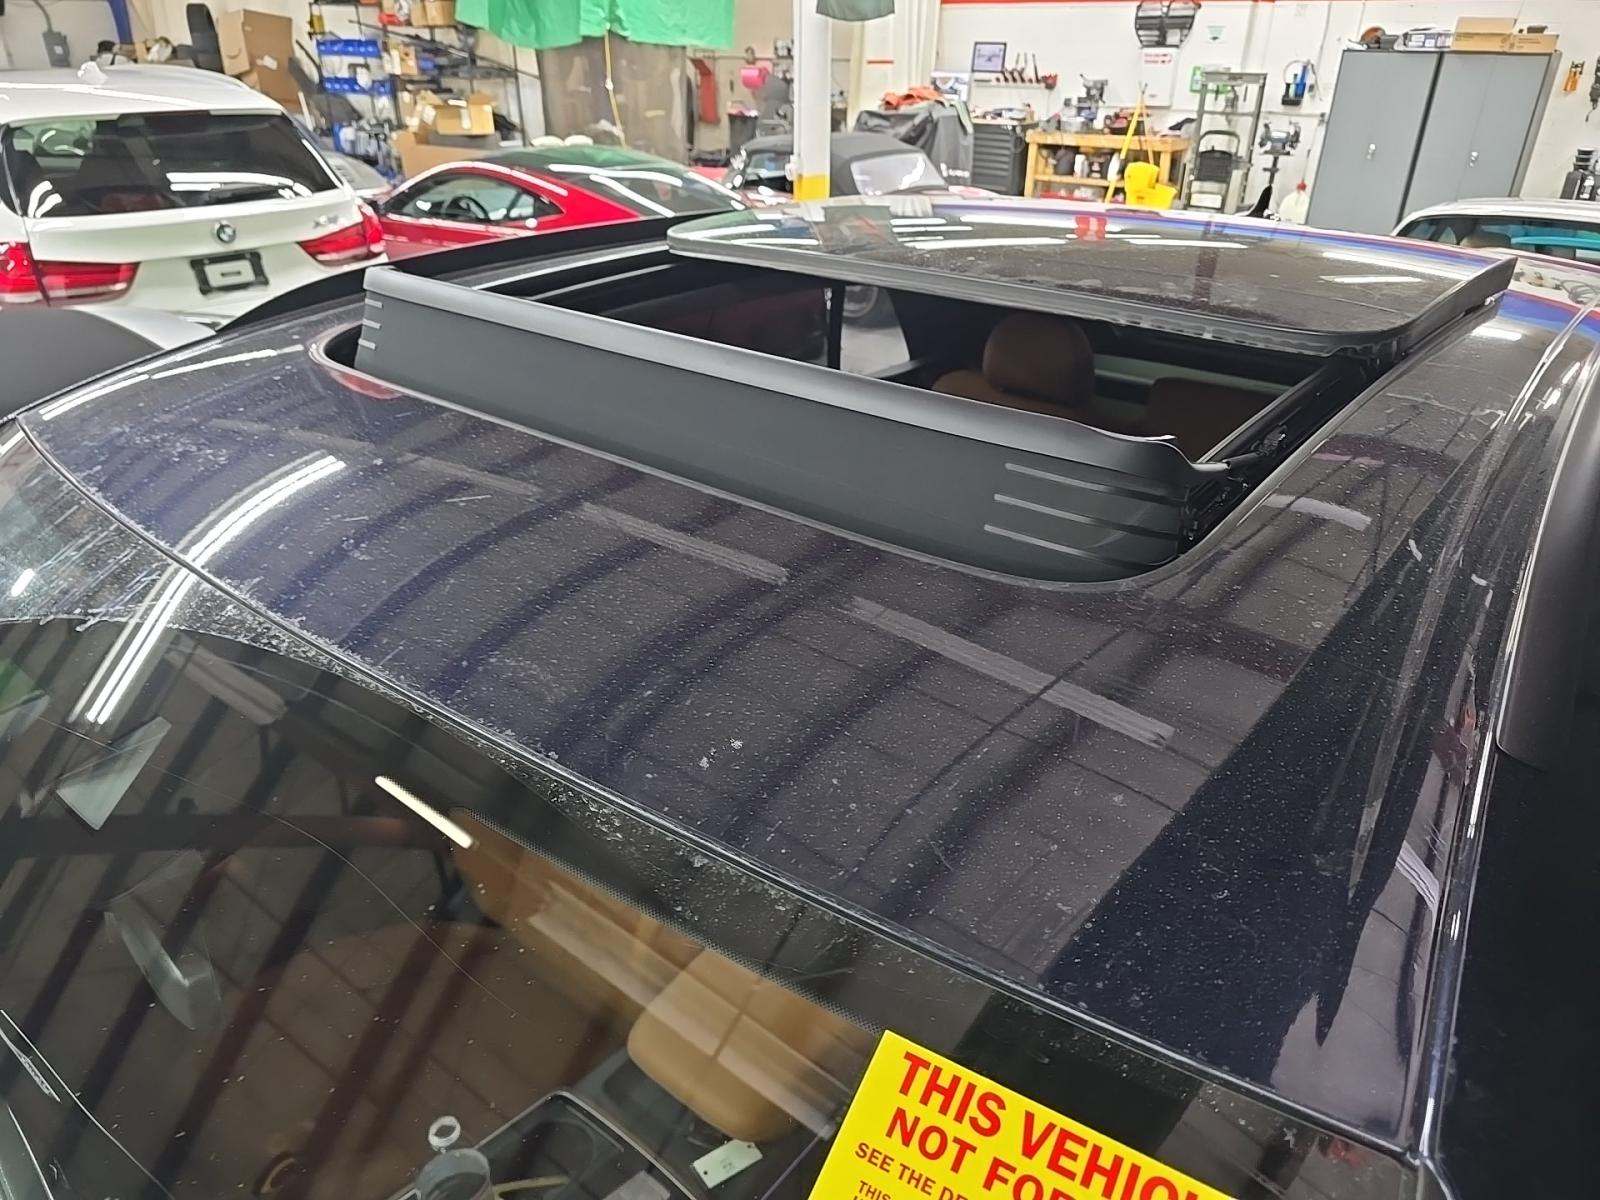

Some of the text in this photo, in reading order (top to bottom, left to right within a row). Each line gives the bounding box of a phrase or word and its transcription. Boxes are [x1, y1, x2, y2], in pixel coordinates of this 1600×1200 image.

[899, 1052, 1006, 1137] THIS
[855, 1142, 895, 1173] SEE
[898, 1163, 937, 1196] THE
[886, 1106, 977, 1174] NOT
